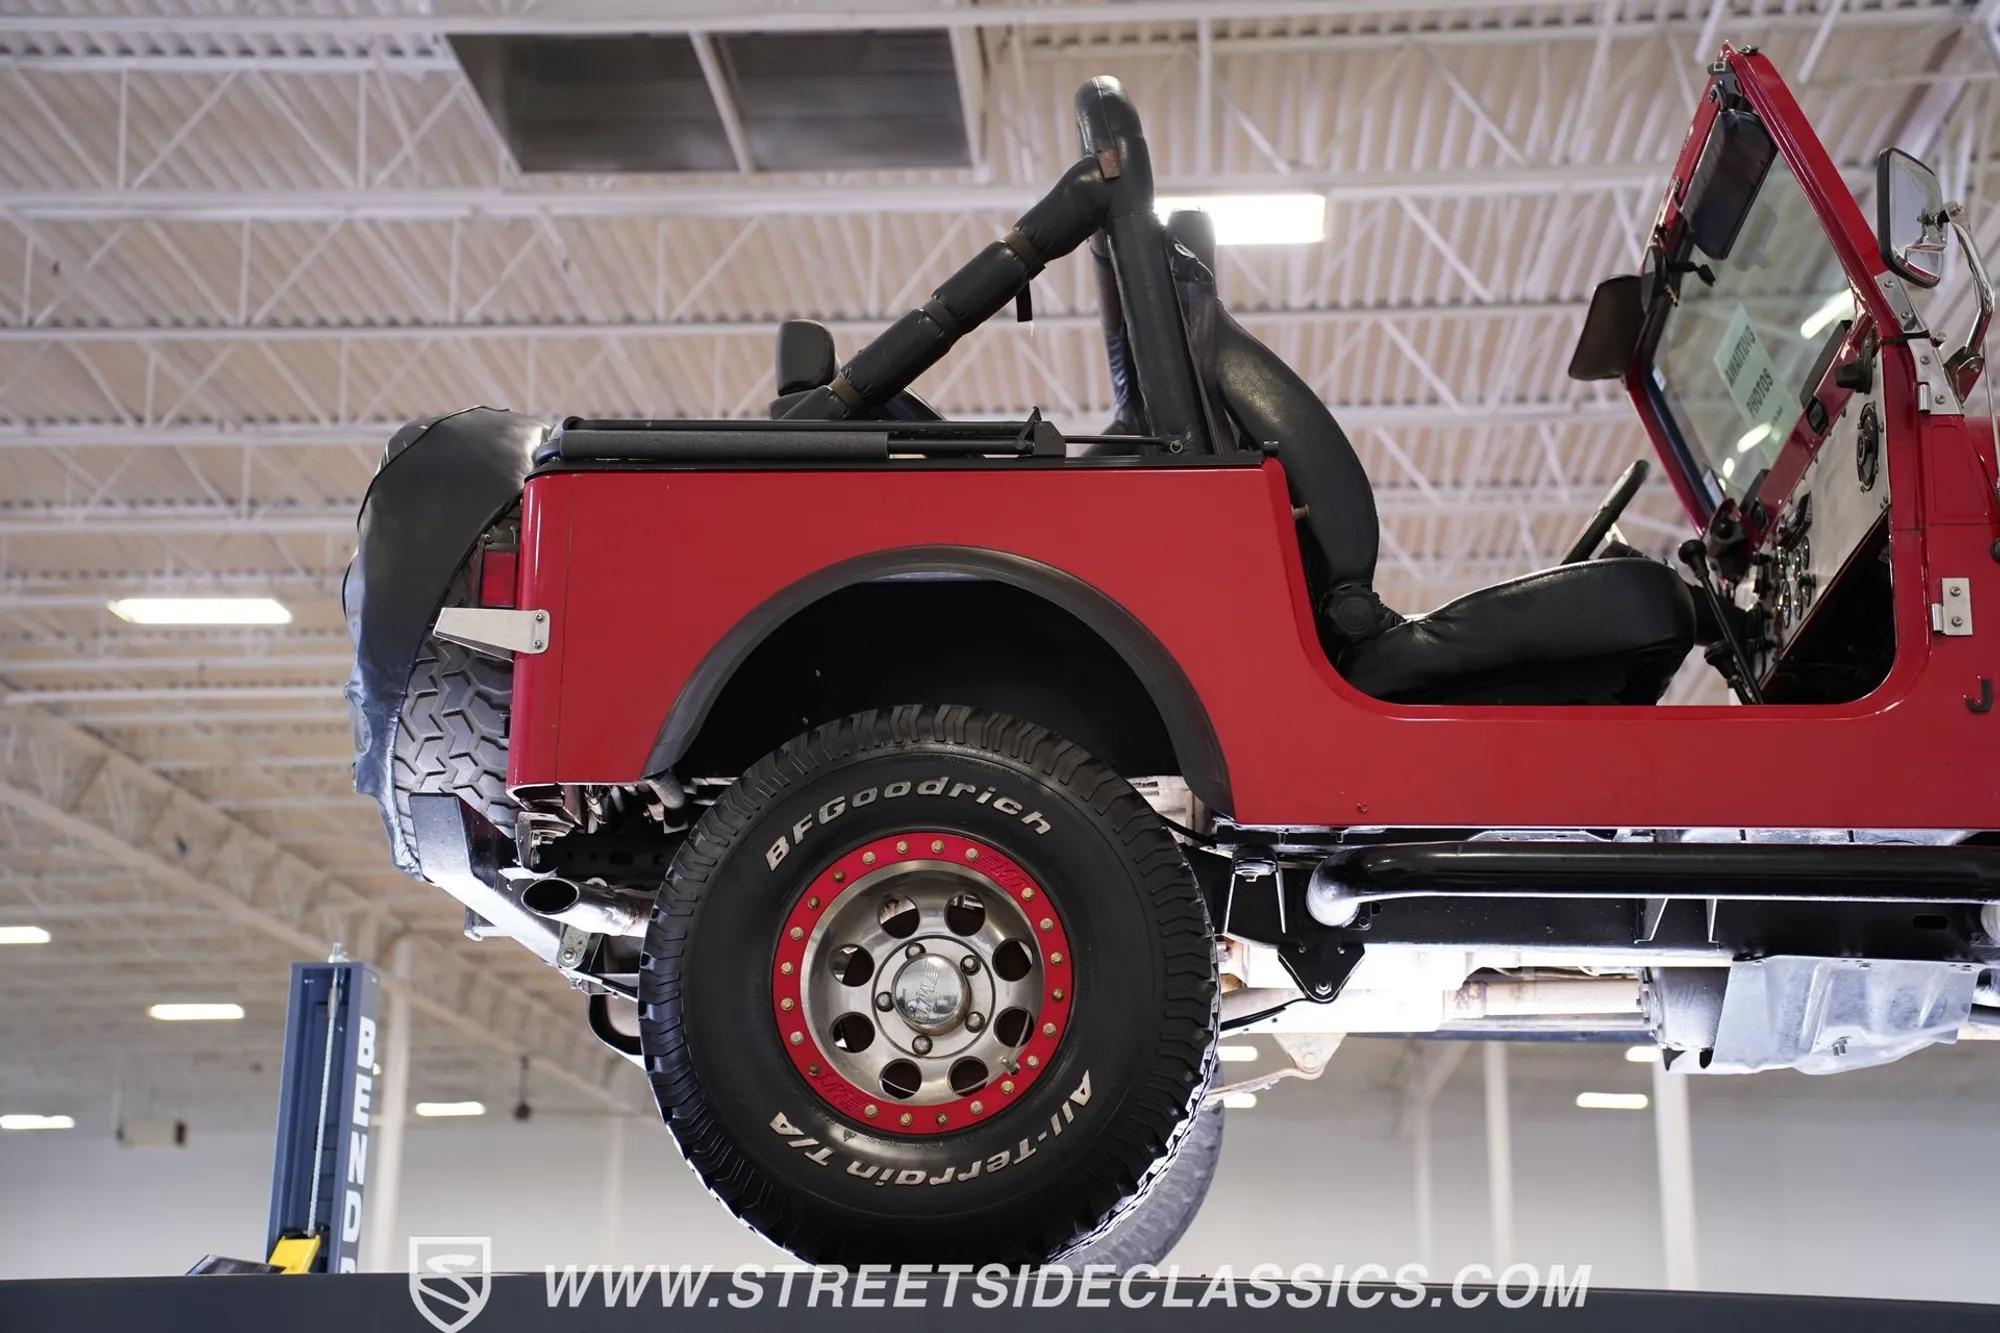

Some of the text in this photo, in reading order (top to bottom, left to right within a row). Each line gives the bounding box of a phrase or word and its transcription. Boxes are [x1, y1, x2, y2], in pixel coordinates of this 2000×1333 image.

[1724, 324, 1757, 388] AWAITING
[1745, 367, 1774, 419] PHOTOS
[764, 776, 1053, 872] BFGoodrich
[768, 1069, 1093, 1187] All-Terrain T/A
